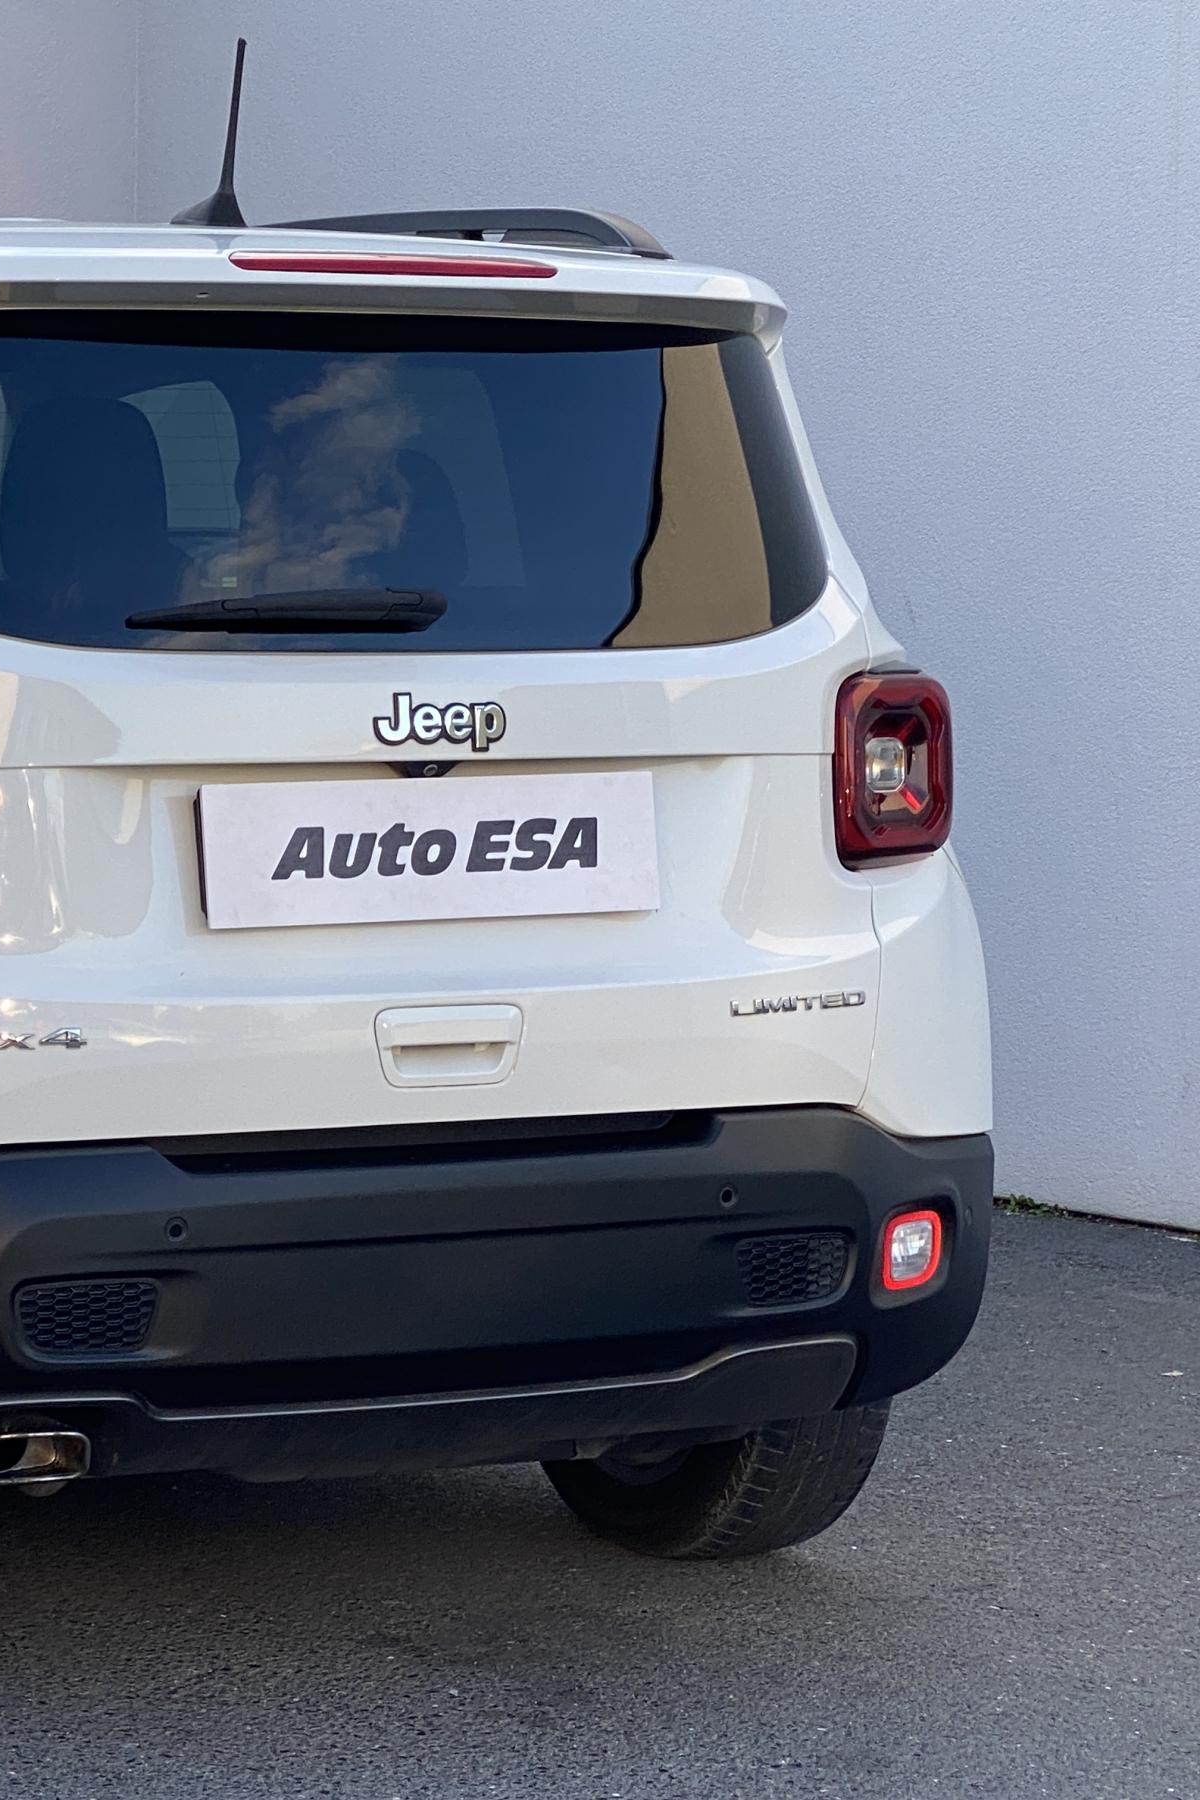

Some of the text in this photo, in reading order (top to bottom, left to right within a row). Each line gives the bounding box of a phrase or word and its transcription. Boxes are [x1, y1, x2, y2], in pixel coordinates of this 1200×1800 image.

[372, 692, 506, 752] Jeep
[271, 816, 598, 880] Auto ESA
[729, 990, 867, 1017] LIMITED
